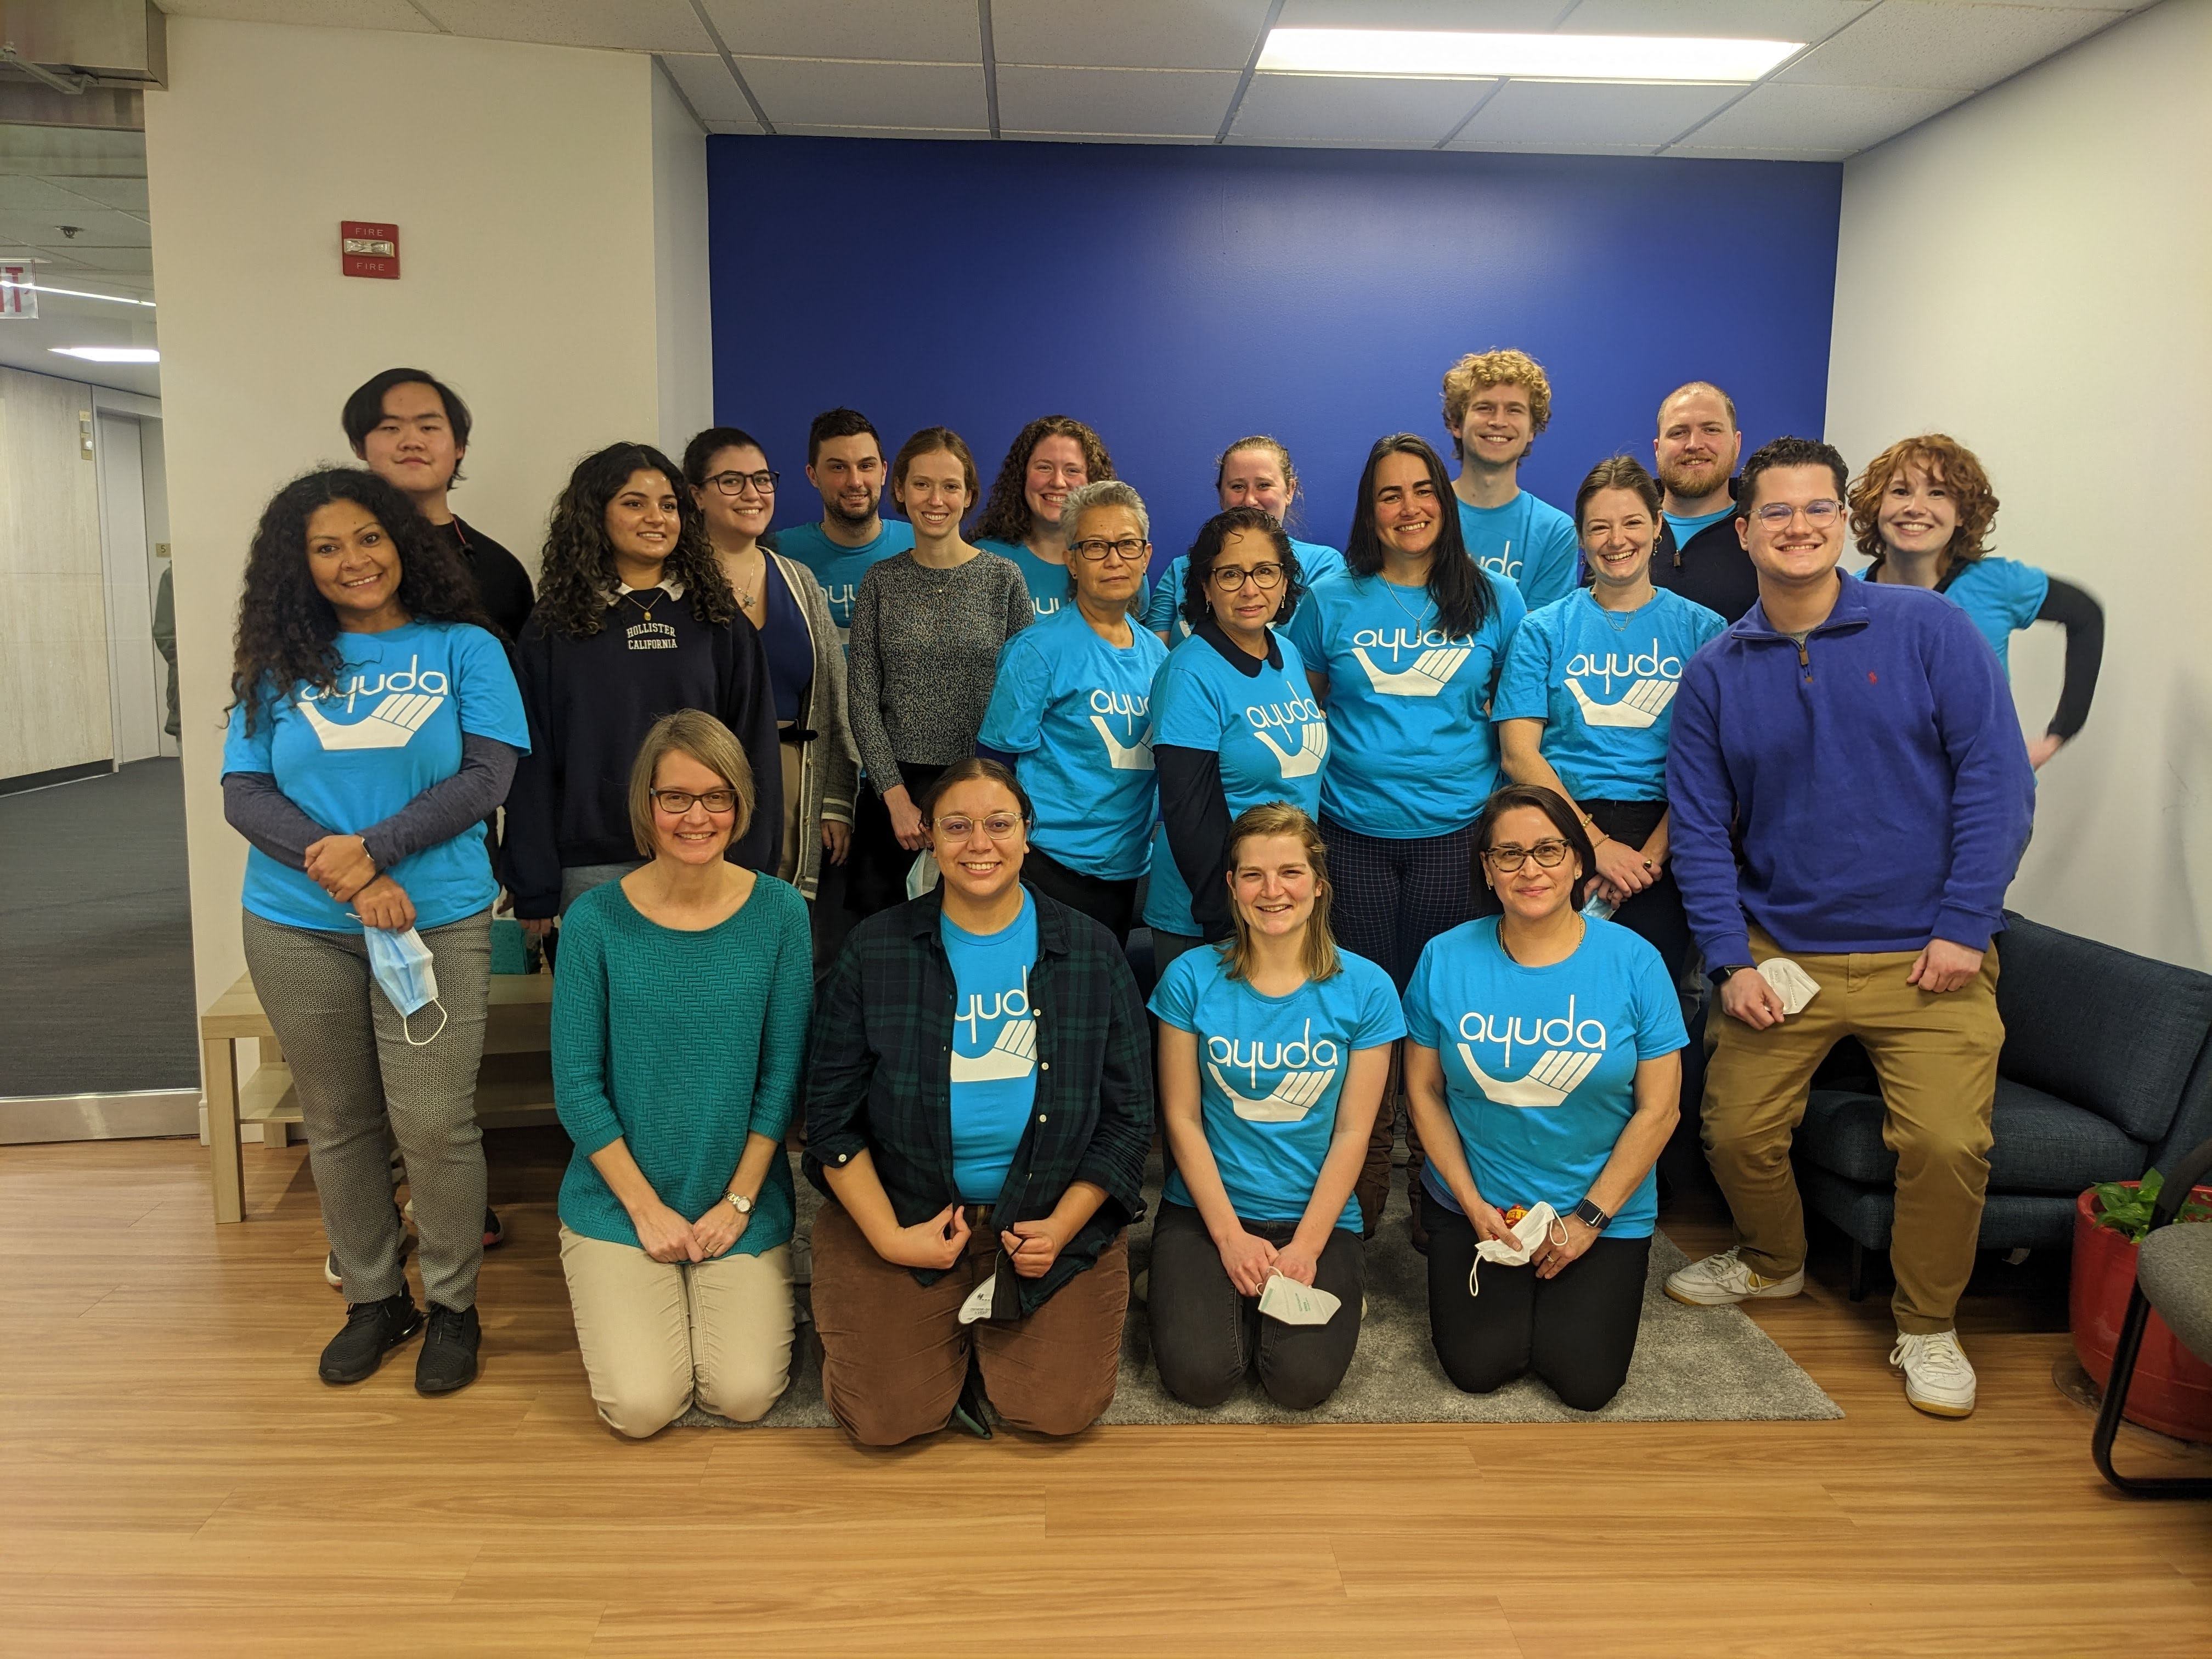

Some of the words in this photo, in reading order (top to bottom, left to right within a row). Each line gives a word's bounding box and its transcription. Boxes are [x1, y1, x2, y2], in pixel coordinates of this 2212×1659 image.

[356, 228, 384, 236] FIRE
[356, 262, 385, 271] FIRE
[161, 545, 166, 553] 5
[625, 622, 676, 639] HOLLISTER
[628, 639, 678, 650] CALIFORNIA
[1566, 637, 1683, 695] ayuda
[1246, 680, 1324, 743] ayuda
[1459, 994, 1606, 1068] ayuda
[1207, 1018, 1339, 1089] ayuda
